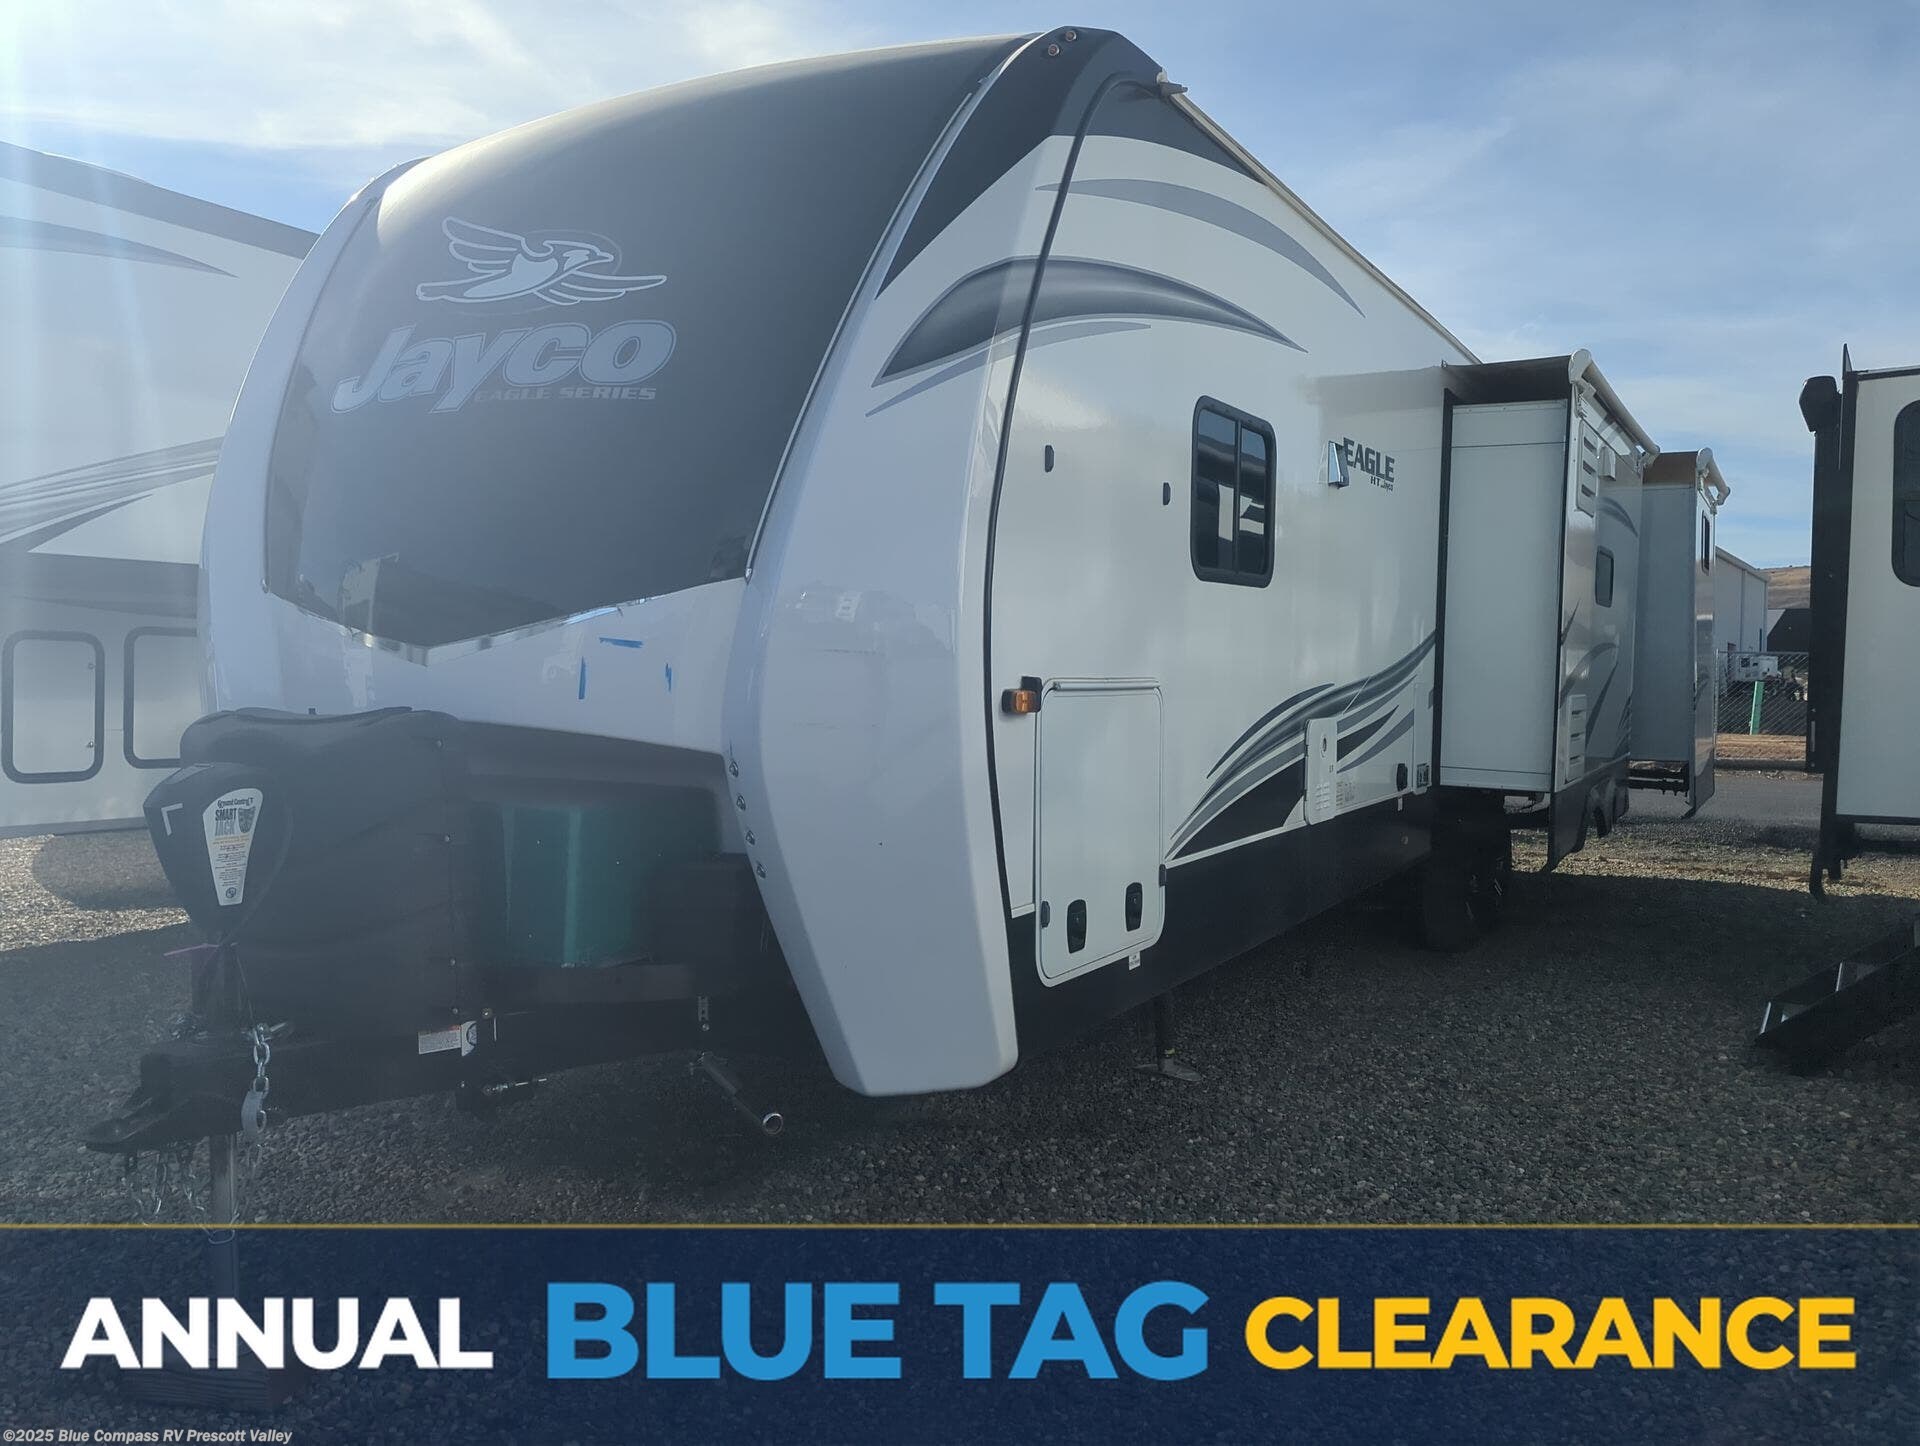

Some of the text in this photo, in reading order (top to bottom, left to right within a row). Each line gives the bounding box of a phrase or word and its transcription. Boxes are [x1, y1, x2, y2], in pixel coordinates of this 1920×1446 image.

[474, 386, 657, 402] EAGLE SERIES
[1343, 437, 1395, 483] EAGLE
[215, 807, 238, 822] SMART
